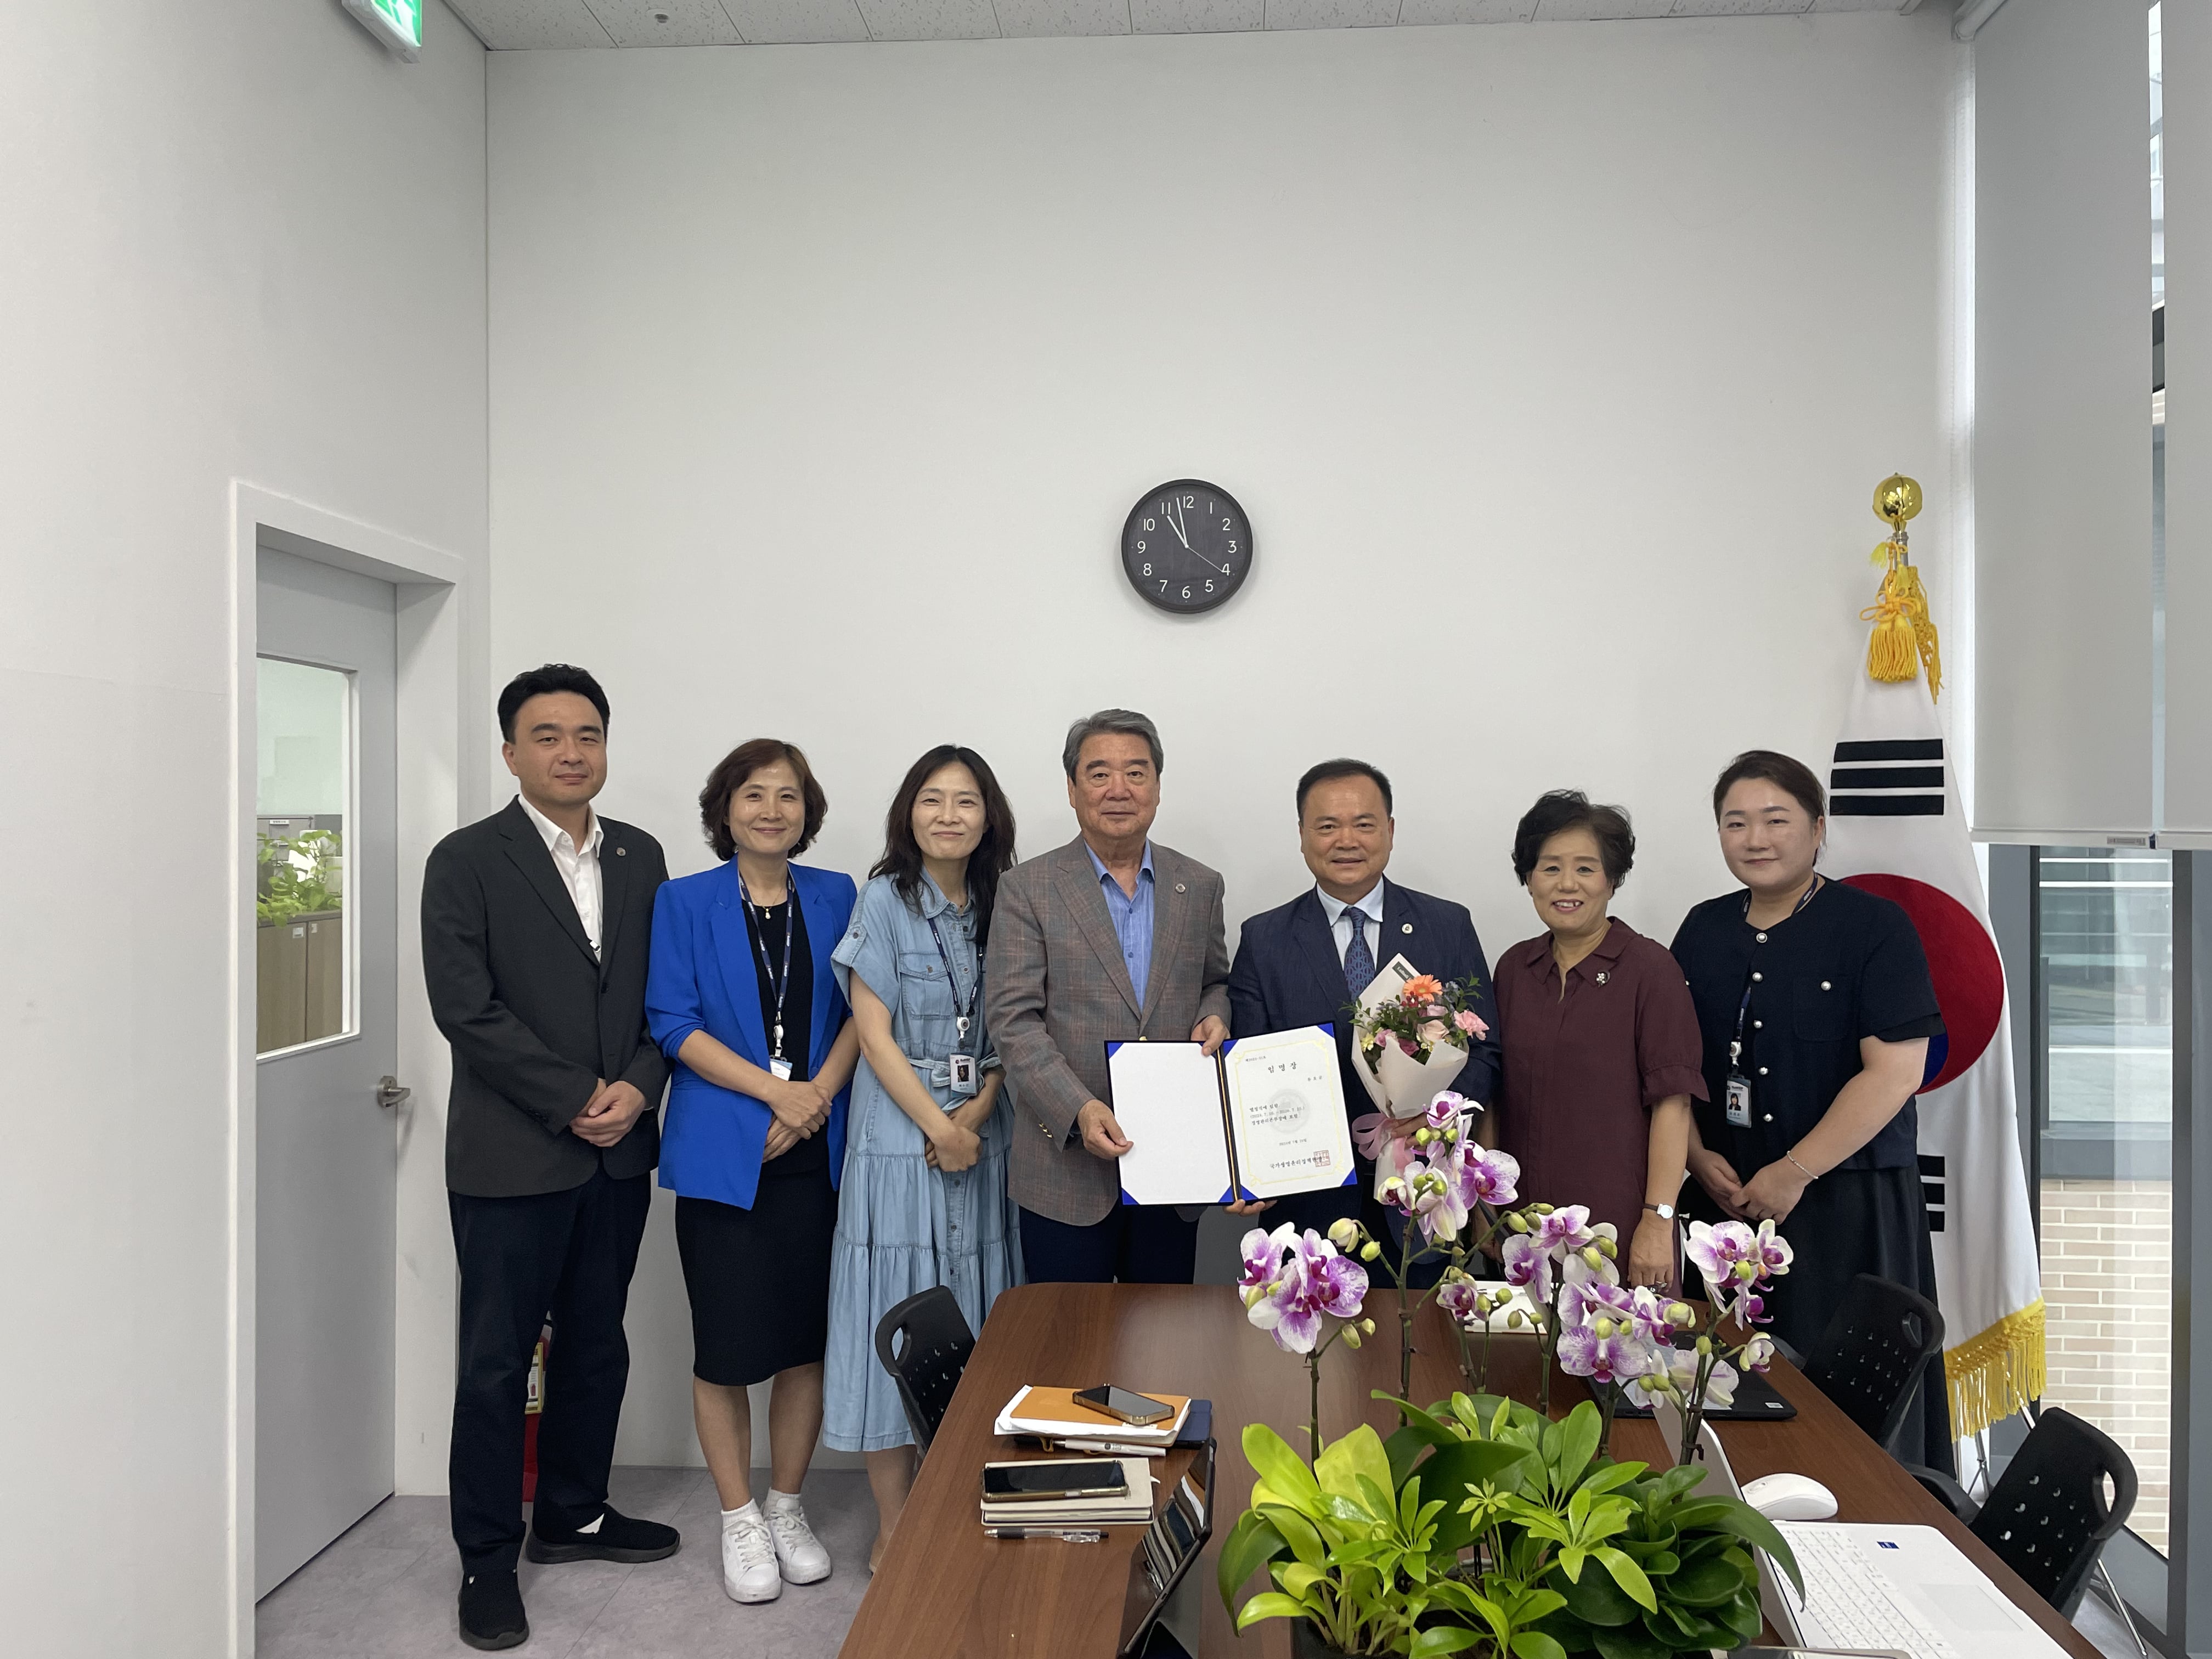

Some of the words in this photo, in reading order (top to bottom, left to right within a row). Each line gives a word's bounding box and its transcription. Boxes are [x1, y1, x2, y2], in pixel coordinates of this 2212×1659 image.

[1161, 502, 1171, 515] 11
[1183, 495, 1194, 509] 12
[1209, 501, 1212, 514] 1
[1143, 518, 1155, 531] 10
[1222, 518, 1231, 531] 2
[1137, 540, 1146, 554] 9
[1228, 540, 1237, 553] 3
[1143, 563, 1152, 576] 8
[1221, 563, 1231, 576] 4
[1159, 580, 1168, 592] 7
[1182, 585, 1190, 599] 6
[1205, 579, 1214, 592] 5
